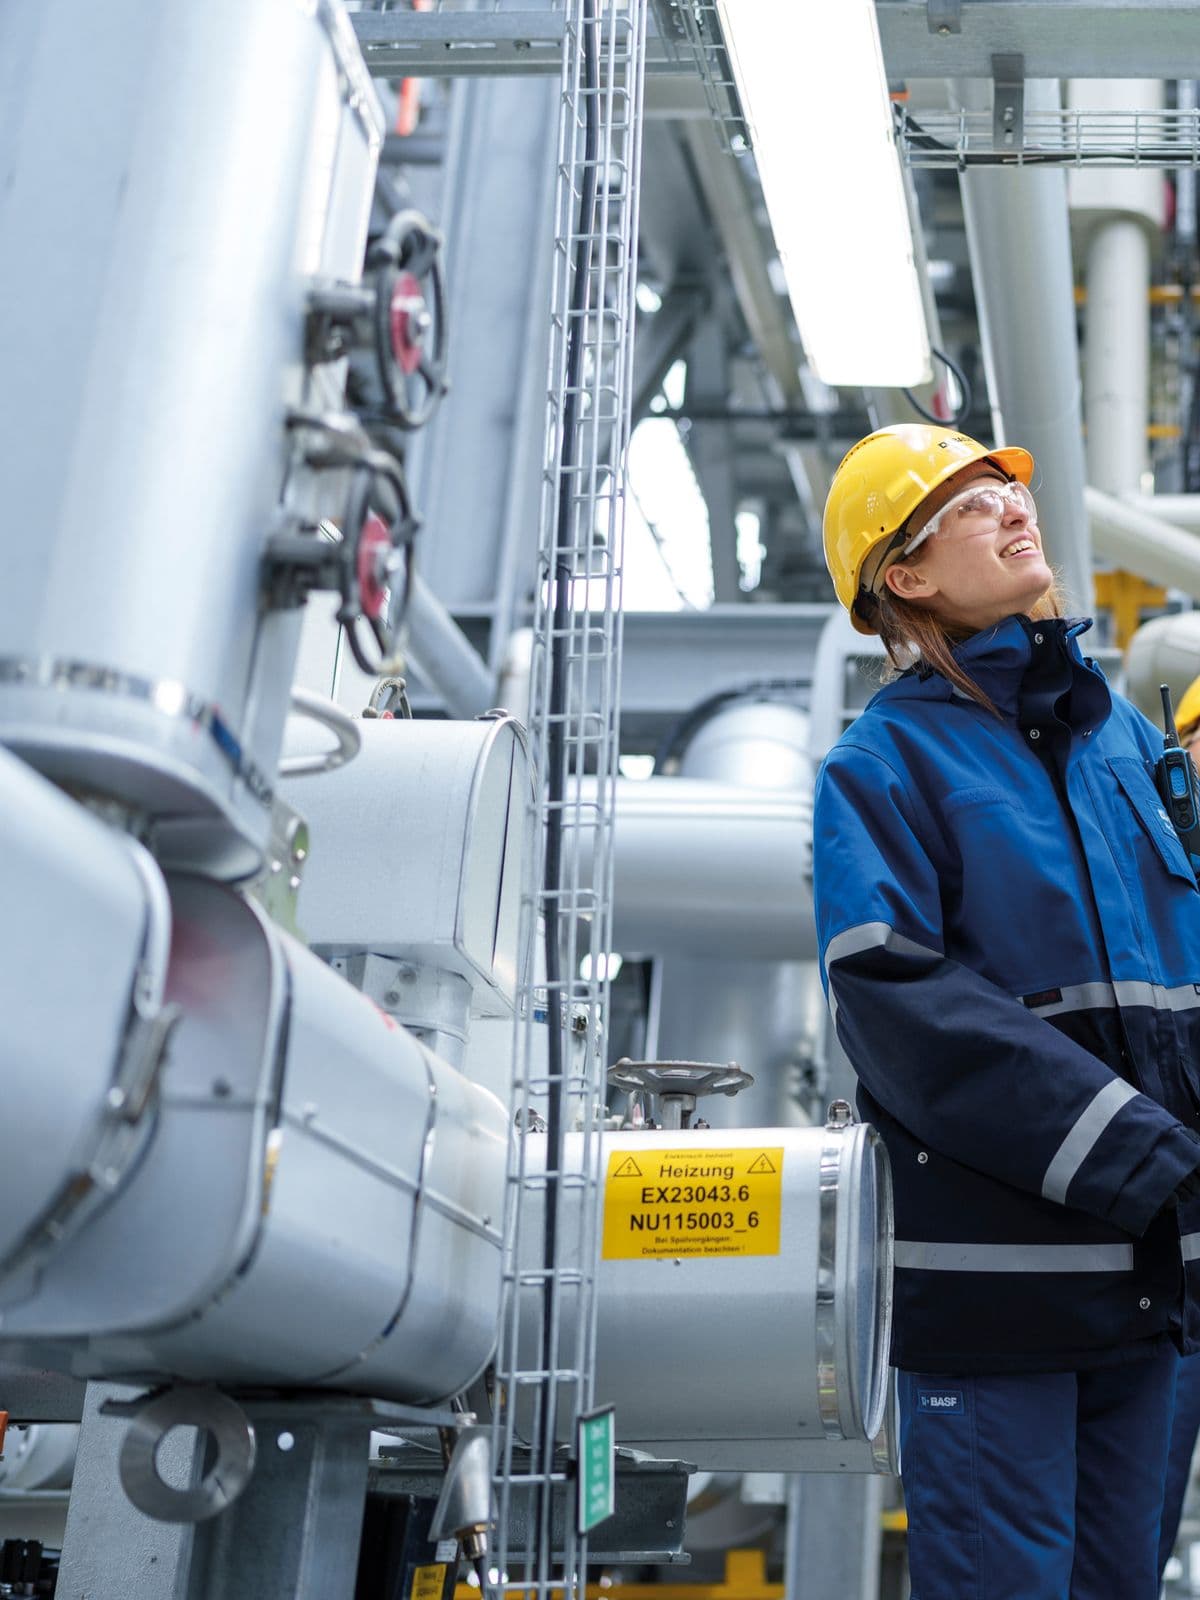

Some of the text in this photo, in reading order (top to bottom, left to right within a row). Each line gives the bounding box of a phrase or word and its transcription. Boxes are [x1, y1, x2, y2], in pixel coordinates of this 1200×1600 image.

[660, 1164, 734, 1180] Heizung
[641, 1186, 750, 1204] EX23043.6
[630, 1211, 759, 1233] NU115003_6
[930, 1396, 957, 1407] BASF
